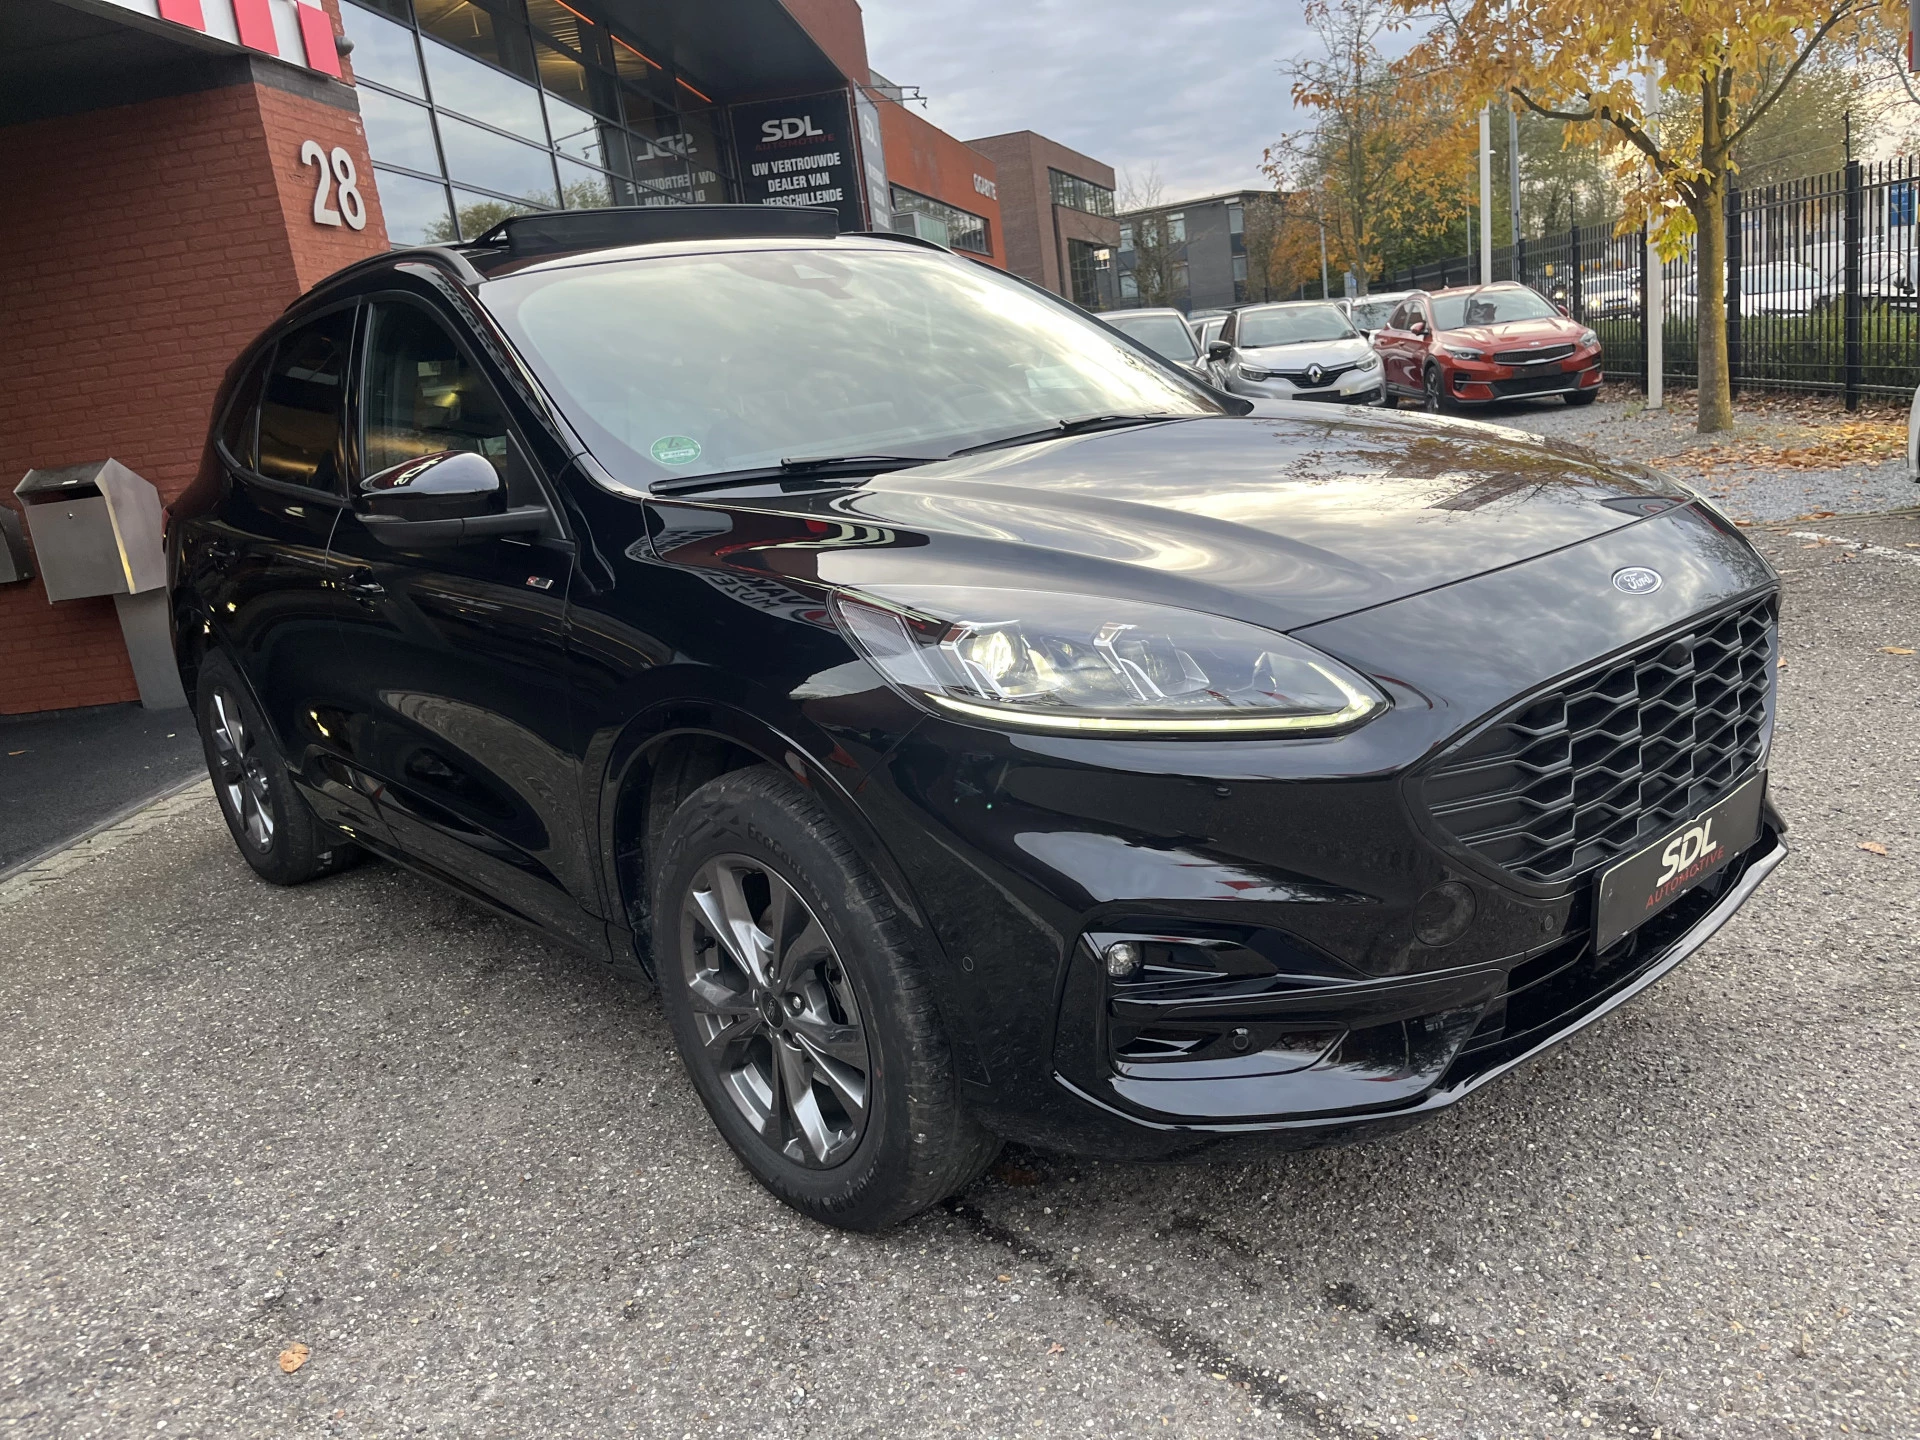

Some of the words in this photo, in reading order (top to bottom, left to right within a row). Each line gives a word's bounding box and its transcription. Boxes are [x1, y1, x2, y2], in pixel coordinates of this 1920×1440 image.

[762, 115, 823, 142] SDL
[755, 133, 836, 151] AUTOMOTIVE
[751, 162, 769, 177] UW
[770, 152, 841, 174] VERTROUWDE
[301, 140, 366, 230] 28
[767, 175, 807, 193] DEALER
[808, 171, 830, 187] VAN
[762, 188, 843, 207] VERSCHILLENDE
[1623, 572, 1653, 590] Ford
[1656, 818, 1717, 888] SDL
[1645, 846, 1725, 910] AUTOMOTIVE
